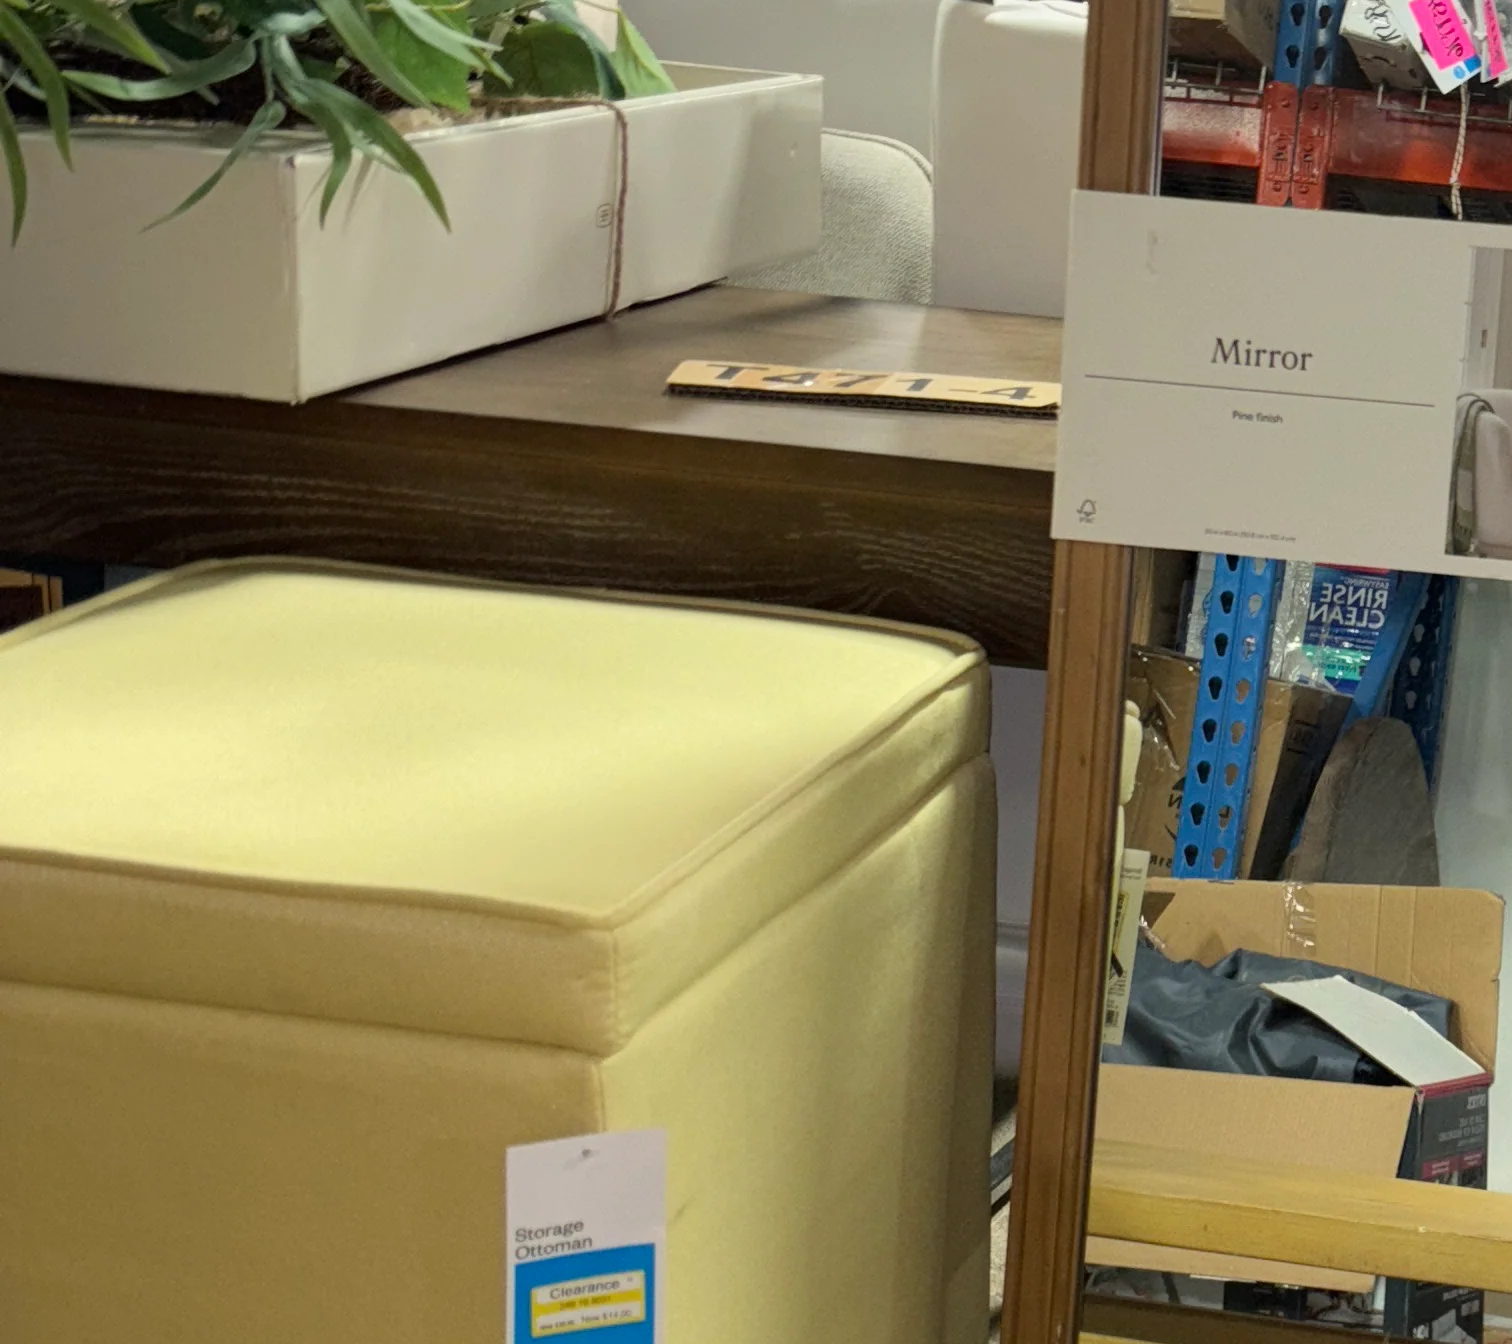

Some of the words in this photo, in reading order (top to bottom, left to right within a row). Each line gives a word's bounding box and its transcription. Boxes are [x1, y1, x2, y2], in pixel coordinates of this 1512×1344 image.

[1210, 337, 1314, 372] Mirror
[1232, 409, 1254, 422] Pine
[1255, 411, 1284, 424] finish
[515, 1220, 585, 1244] Storage
[515, 1235, 593, 1261] Ottoman
[550, 1278, 620, 1301] Clearance
